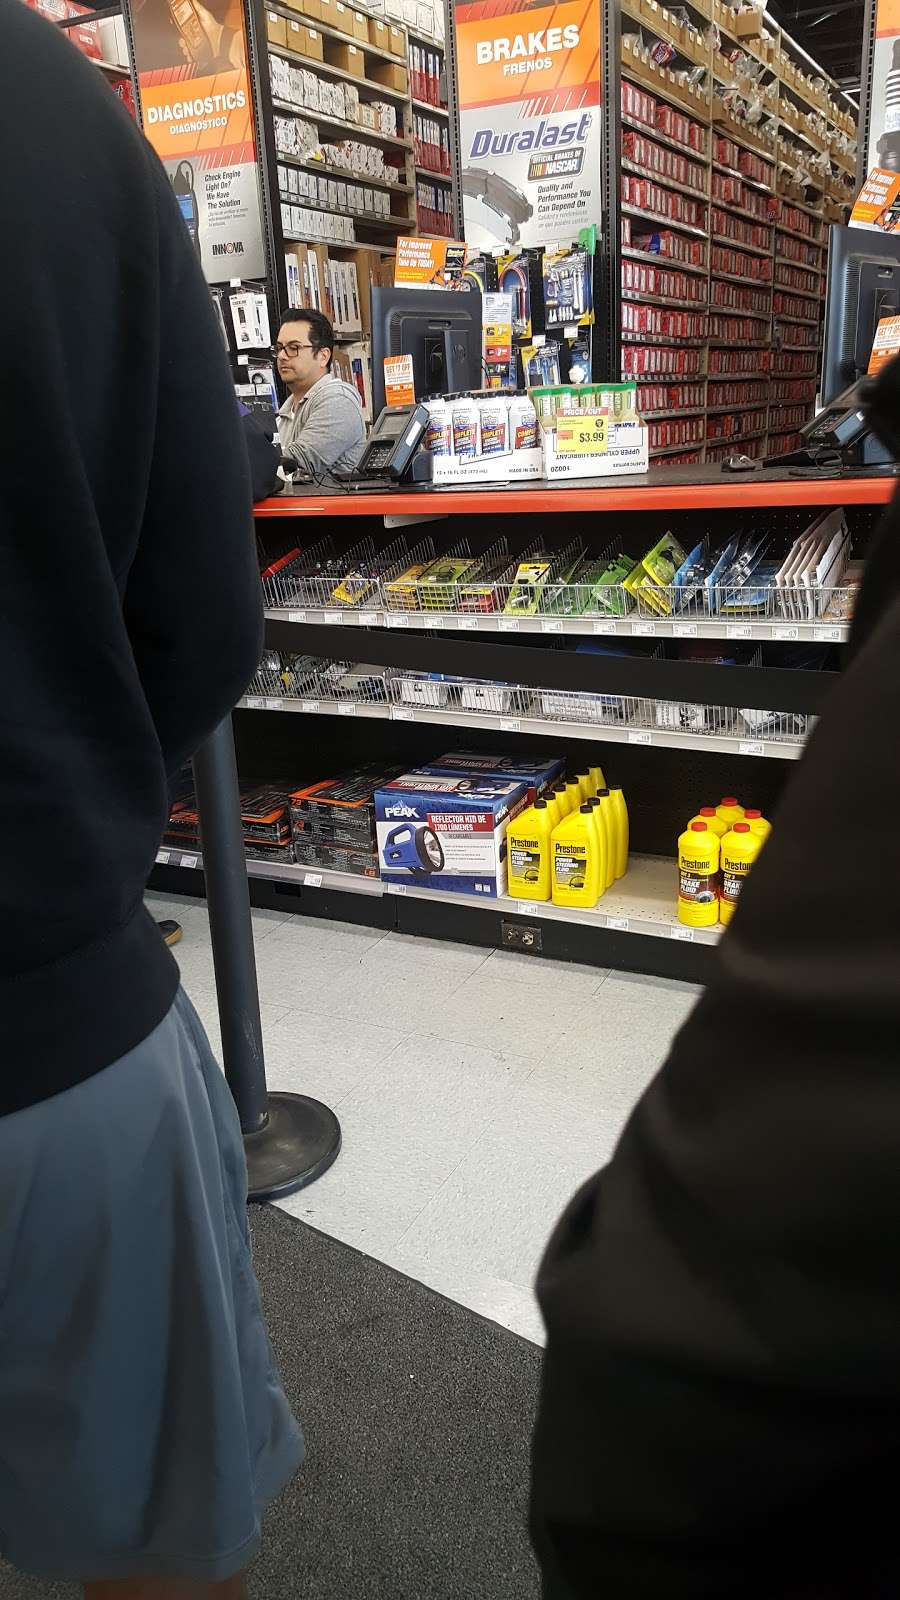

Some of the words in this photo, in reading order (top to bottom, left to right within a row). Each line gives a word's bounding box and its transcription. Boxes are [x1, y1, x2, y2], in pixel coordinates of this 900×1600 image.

[476, 24, 580, 65] BRAKES
[503, 57, 553, 76] FRENOS
[147, 90, 246, 123] DIAGNOSTICS
[470, 113, 590, 158] Duralast
[546, 158, 578, 175] NASCAR
[205, 174, 221, 182] Check
[222, 170, 241, 179] Engine
[206, 183, 220, 191] Light
[220, 181, 231, 189] On?
[537, 184, 559, 194] Quality
[561, 181, 573, 190] and
[216, 191, 230, 199] Have
[537, 192, 578, 203] Performance
[580, 189, 592, 198] You
[218, 199, 241, 208] Solution
[537, 205, 550, 213] Can
[551, 201, 576, 213] Depend
[576, 200, 586, 208] On
[212, 241, 244, 256] INNOVA
[580, 432, 604, 443] $3.99
[620, 448, 641, 456] UPPER
[385, 807, 420, 818] PEAK
[431, 815, 464, 823] REFLECTOR
[477, 815, 486, 823] DE
[510, 836, 539, 848] Prestone
[555, 843, 586, 854] Prestone
[681, 856, 710, 869] Prestone
[681, 880, 700, 888] BRAKE
[681, 885, 697, 893] FLUID
